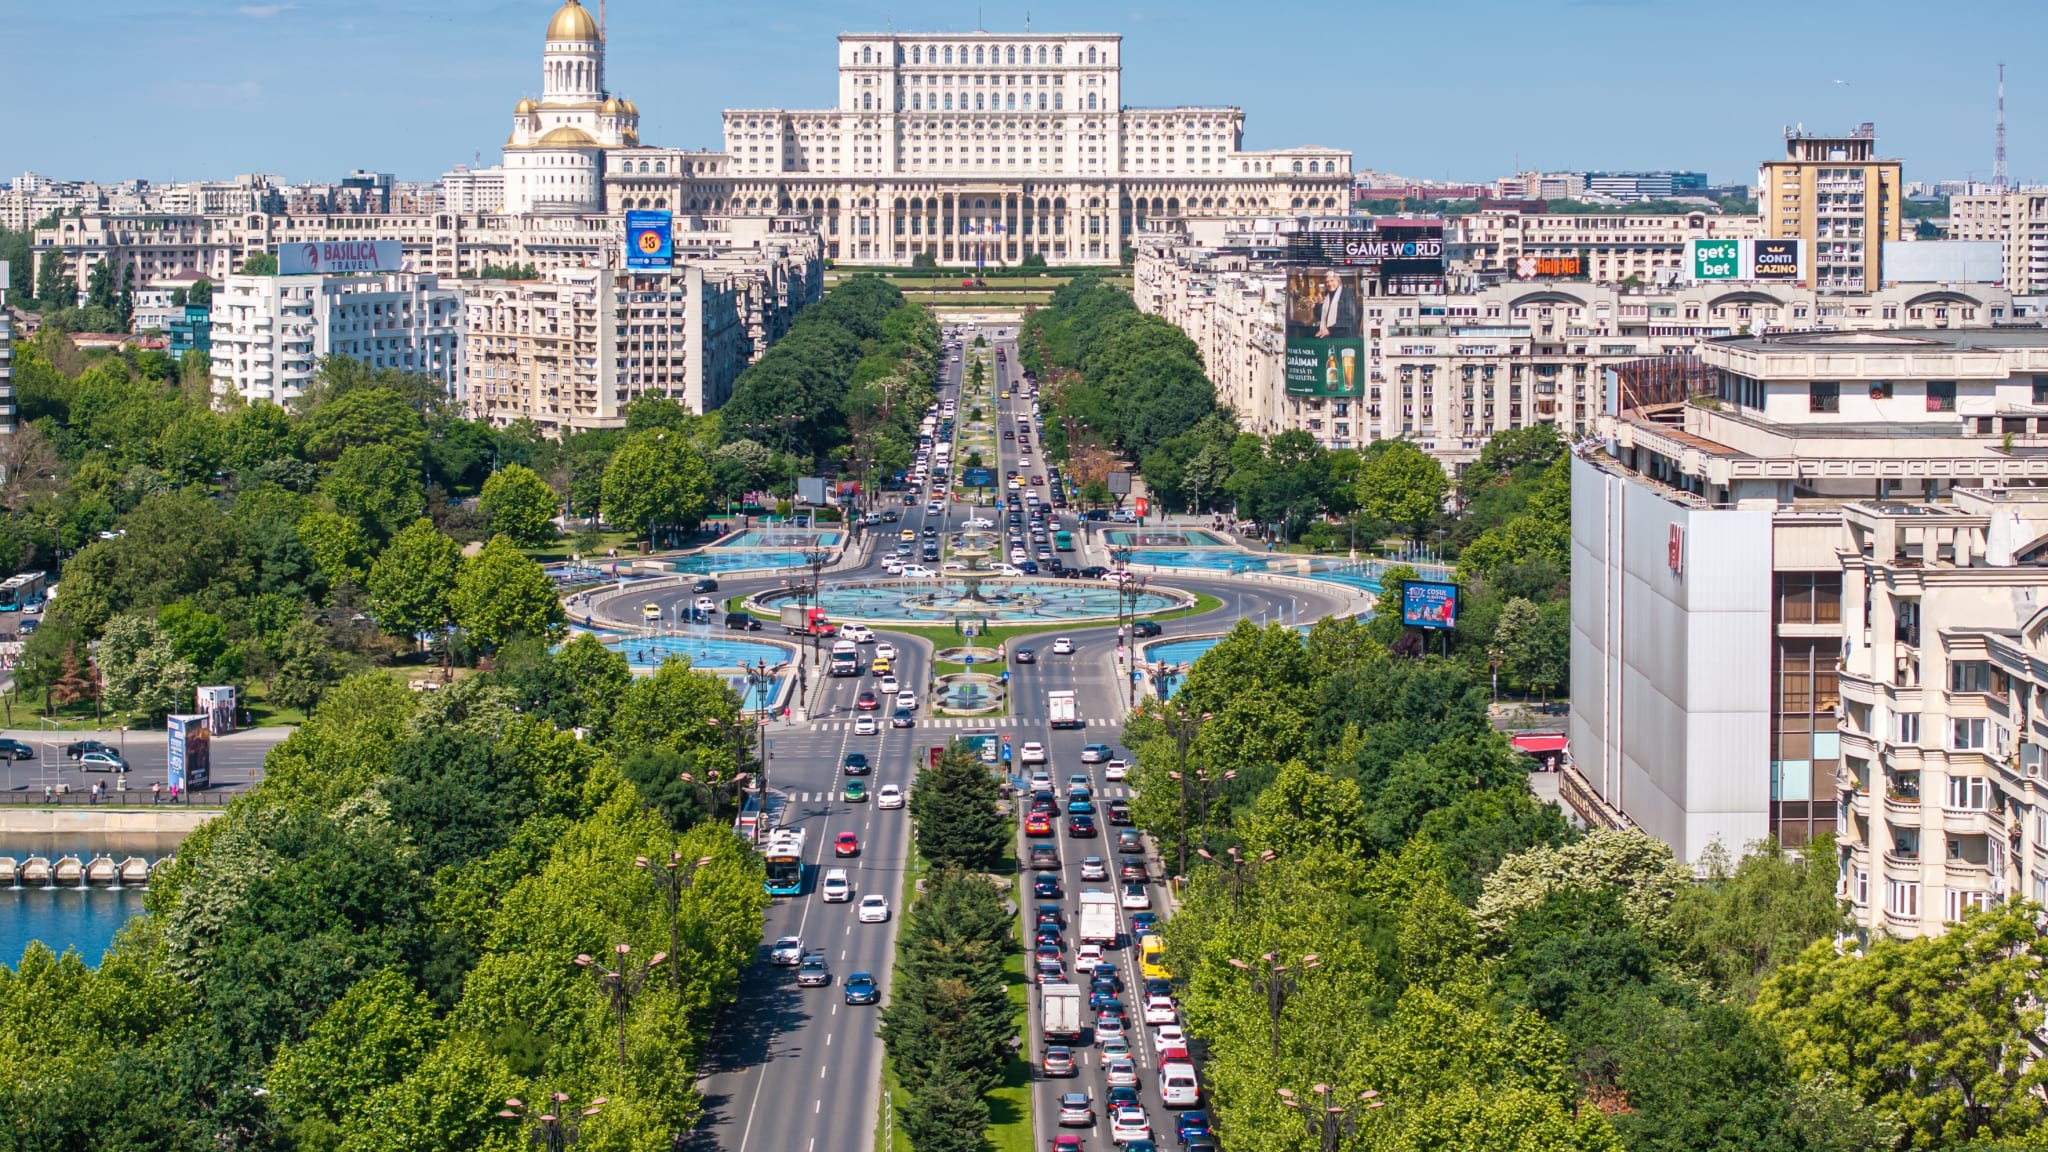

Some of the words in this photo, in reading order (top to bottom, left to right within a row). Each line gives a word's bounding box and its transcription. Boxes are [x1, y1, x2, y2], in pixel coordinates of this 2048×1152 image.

[324, 243, 379, 267] BASILICA
[1346, 243, 1389, 256] GAME
[1391, 242, 1440, 256] WORLD
[1697, 244, 1736, 262] get's
[1758, 254, 1792, 263] CONTI
[331, 261, 369, 270] TRAVEL
[1703, 262, 1730, 275] bet
[1755, 264, 1797, 273] CAZINO
